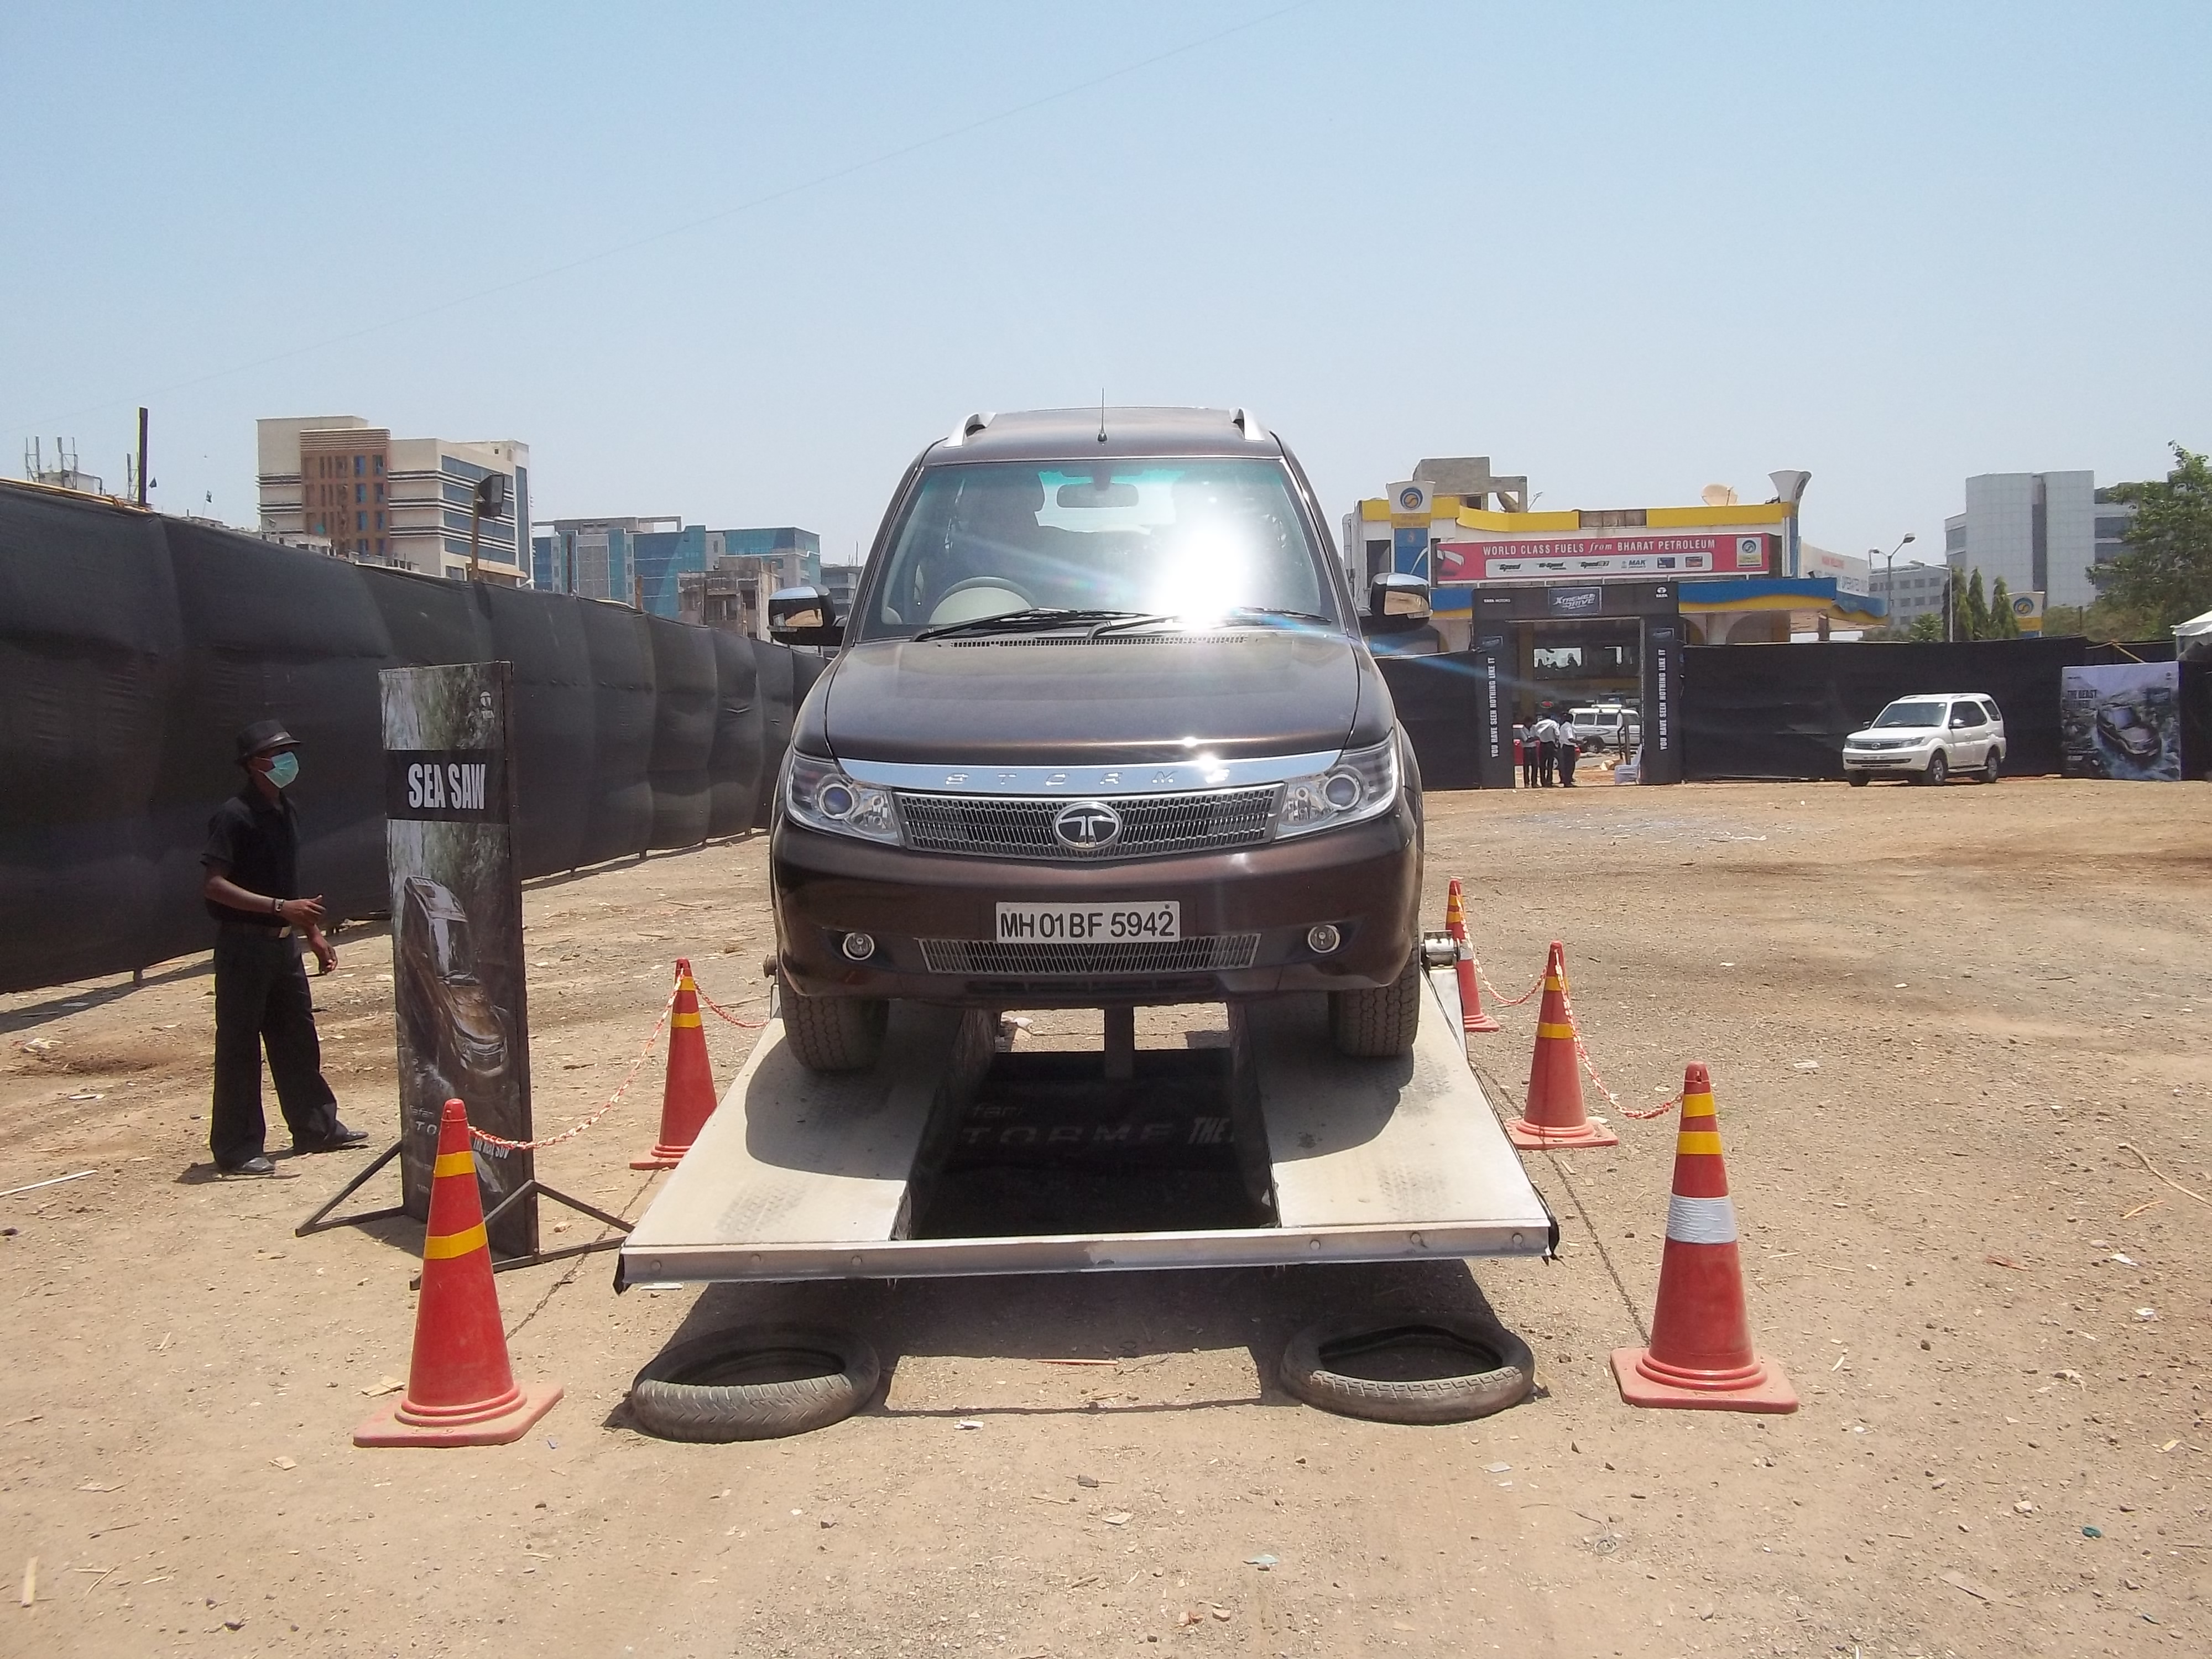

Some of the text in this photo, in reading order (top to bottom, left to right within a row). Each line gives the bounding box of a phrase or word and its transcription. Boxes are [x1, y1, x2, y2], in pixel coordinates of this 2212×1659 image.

[1483, 539, 1715, 556] WORLD CLASS FUELS from BHARAT PETROLEUM
[1658, 657, 1666, 671] LIKE
[1659, 719, 1667, 735] HAVE
[1491, 744, 1499, 758] YOU
[408, 763, 486, 810] SEA SAW
[1110, 911, 1175, 937] 5942
[495, 1145, 510, 1159] SUV
